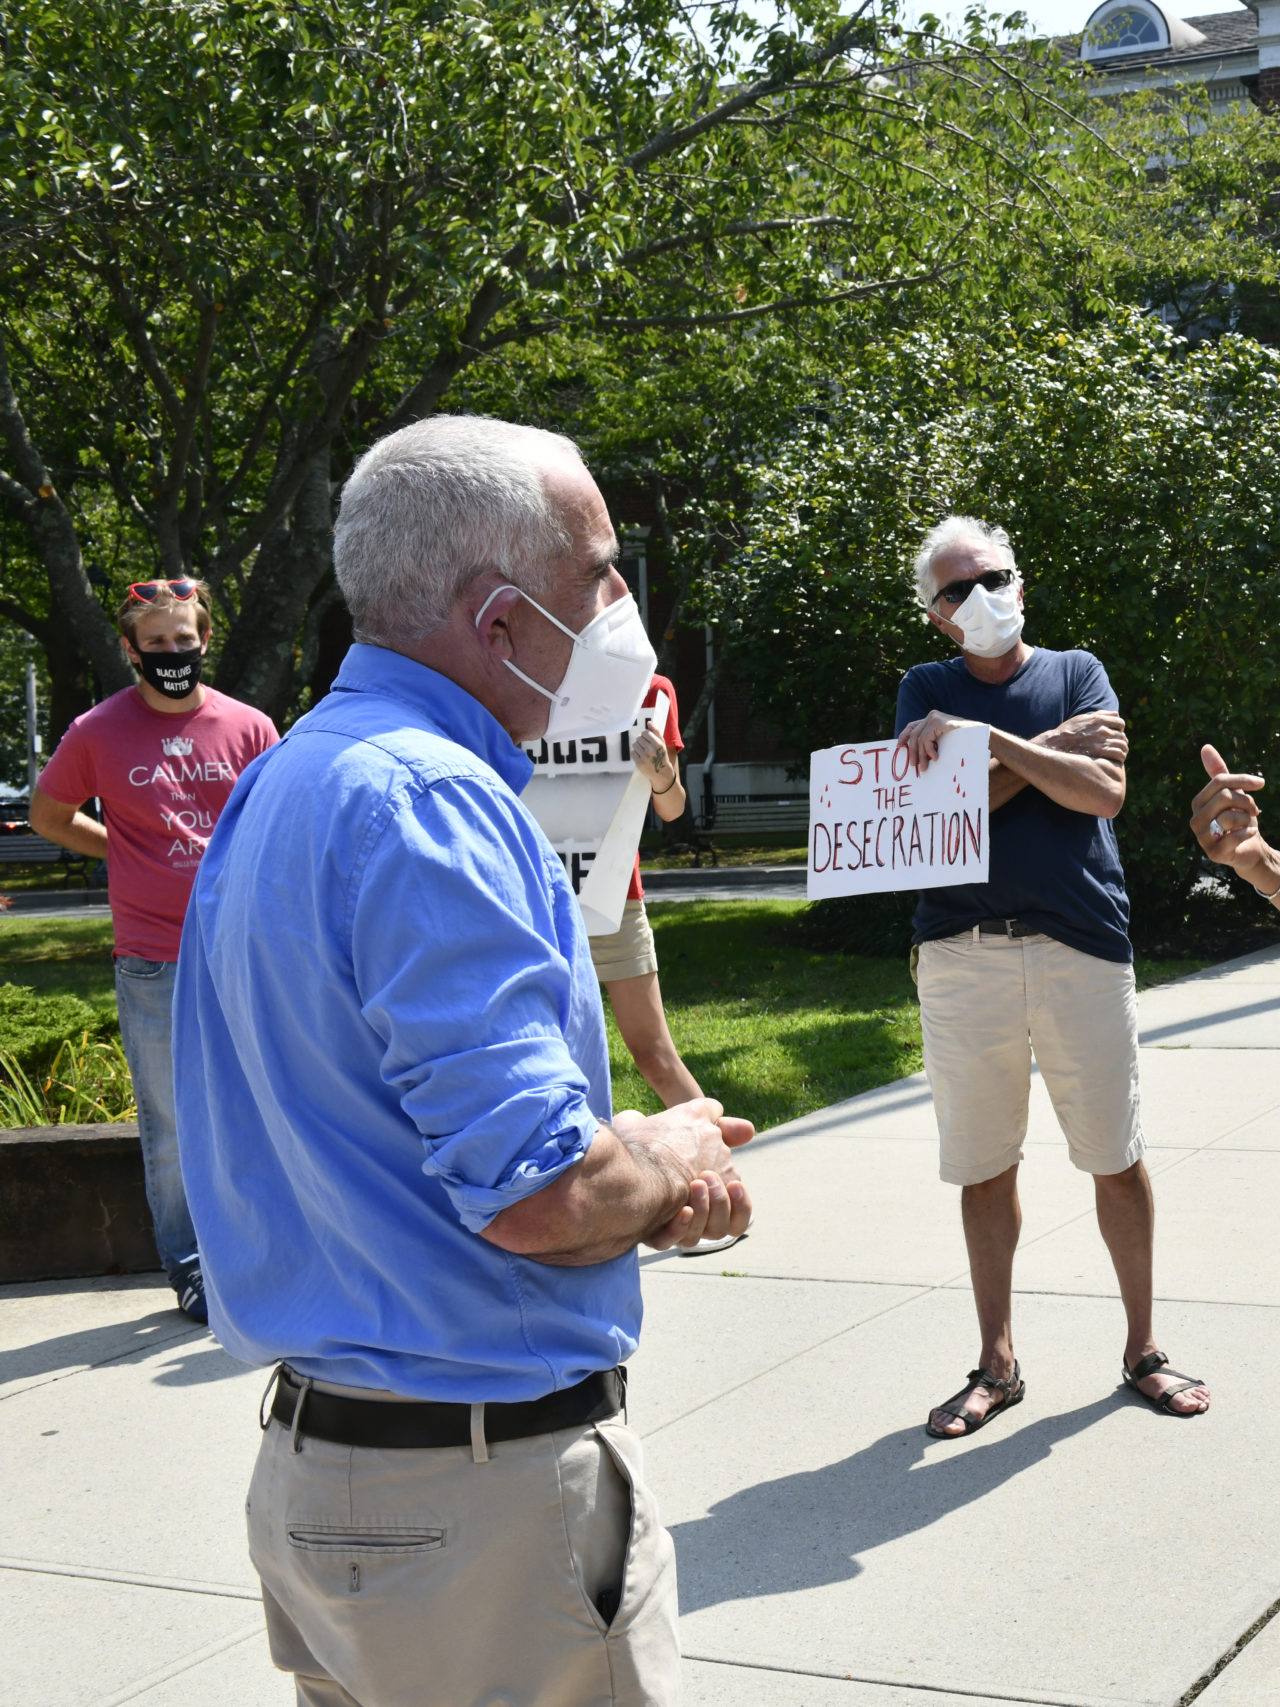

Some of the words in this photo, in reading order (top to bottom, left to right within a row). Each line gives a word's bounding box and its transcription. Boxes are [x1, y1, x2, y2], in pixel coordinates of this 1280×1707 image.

[155, 667, 177, 679] BLACK
[177, 664, 192, 679] LIVES
[163, 680, 190, 691] MATTER
[128, 762, 233, 787] CALMER
[170, 792, 196, 801] THAN
[872, 784, 913, 812] THE
[160, 810, 213, 831] YOU
[813, 807, 982, 873] DESECRATION
